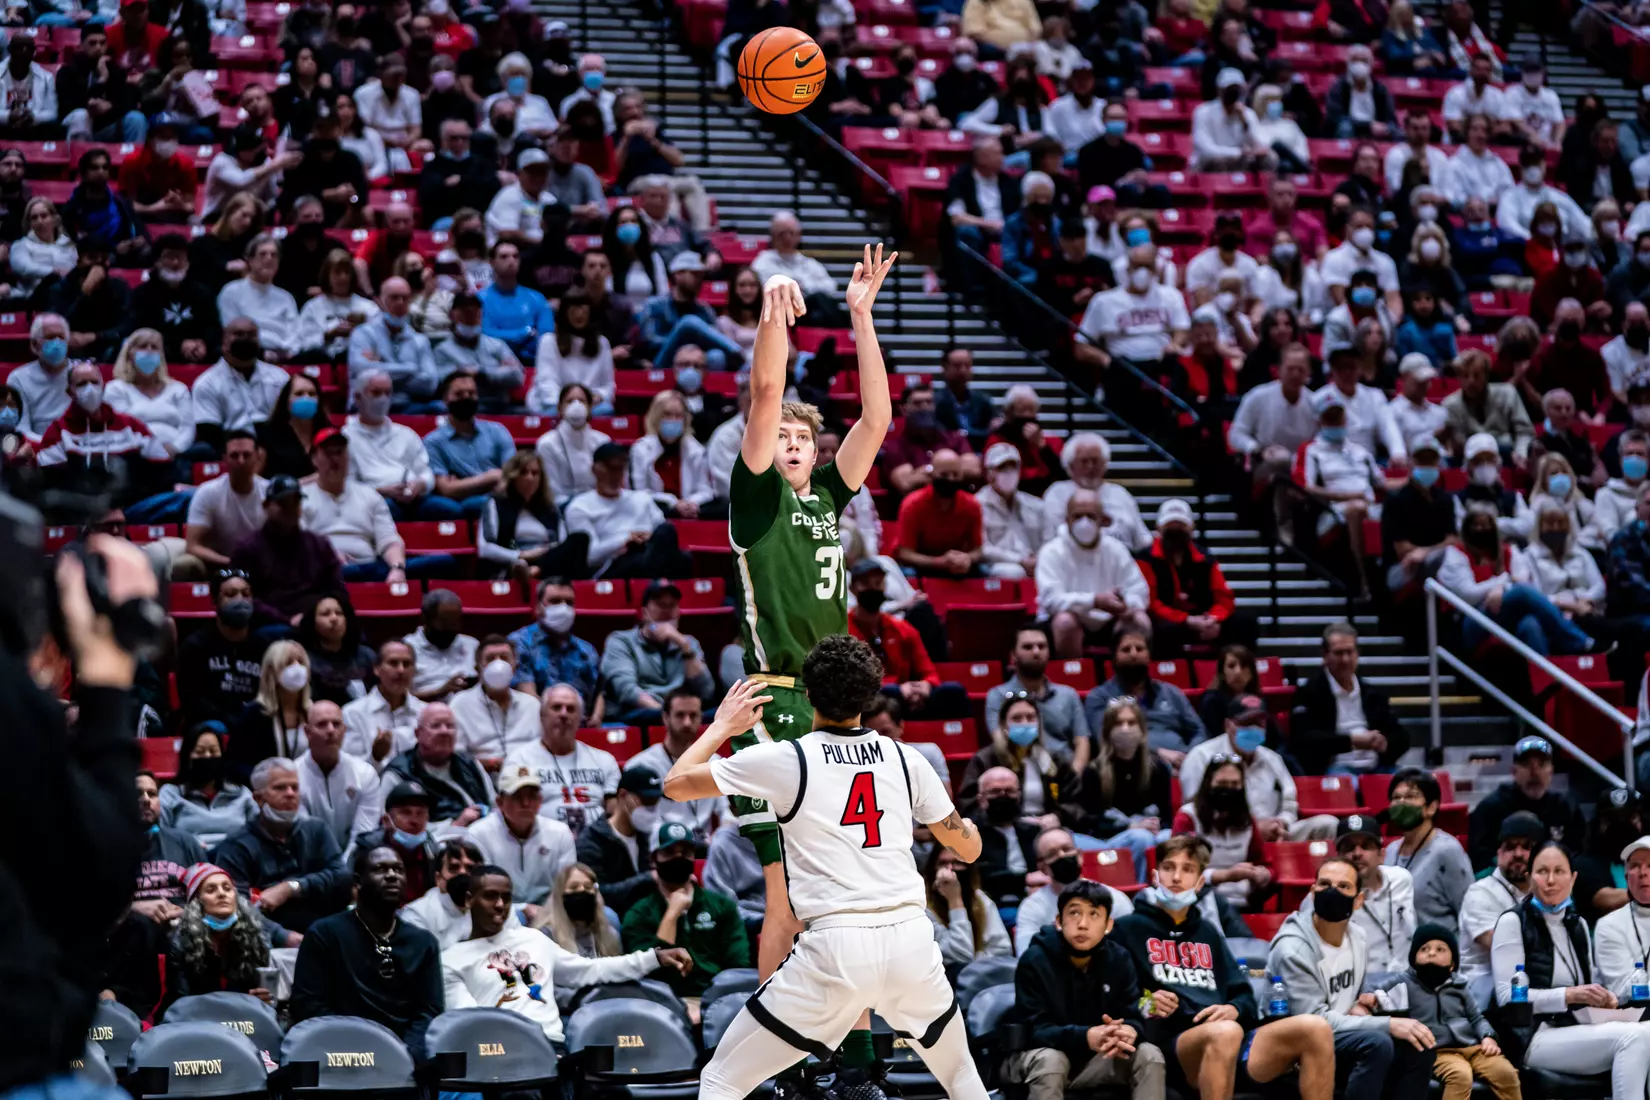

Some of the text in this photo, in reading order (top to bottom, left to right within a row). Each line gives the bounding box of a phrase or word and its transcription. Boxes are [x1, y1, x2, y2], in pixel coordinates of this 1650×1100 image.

[821, 740, 884, 766] PULLIAM
[539, 767, 605, 786] SAN DIEGO
[840, 771, 885, 849] 4
[1146, 937, 1213, 970] SDSU
[1152, 963, 1217, 992] AZTECS
[478, 1043, 506, 1056] ELIA
[617, 1035, 645, 1047] ELIA
[174, 1059, 222, 1076] NEWTON
[326, 1051, 375, 1067] NEWTON
